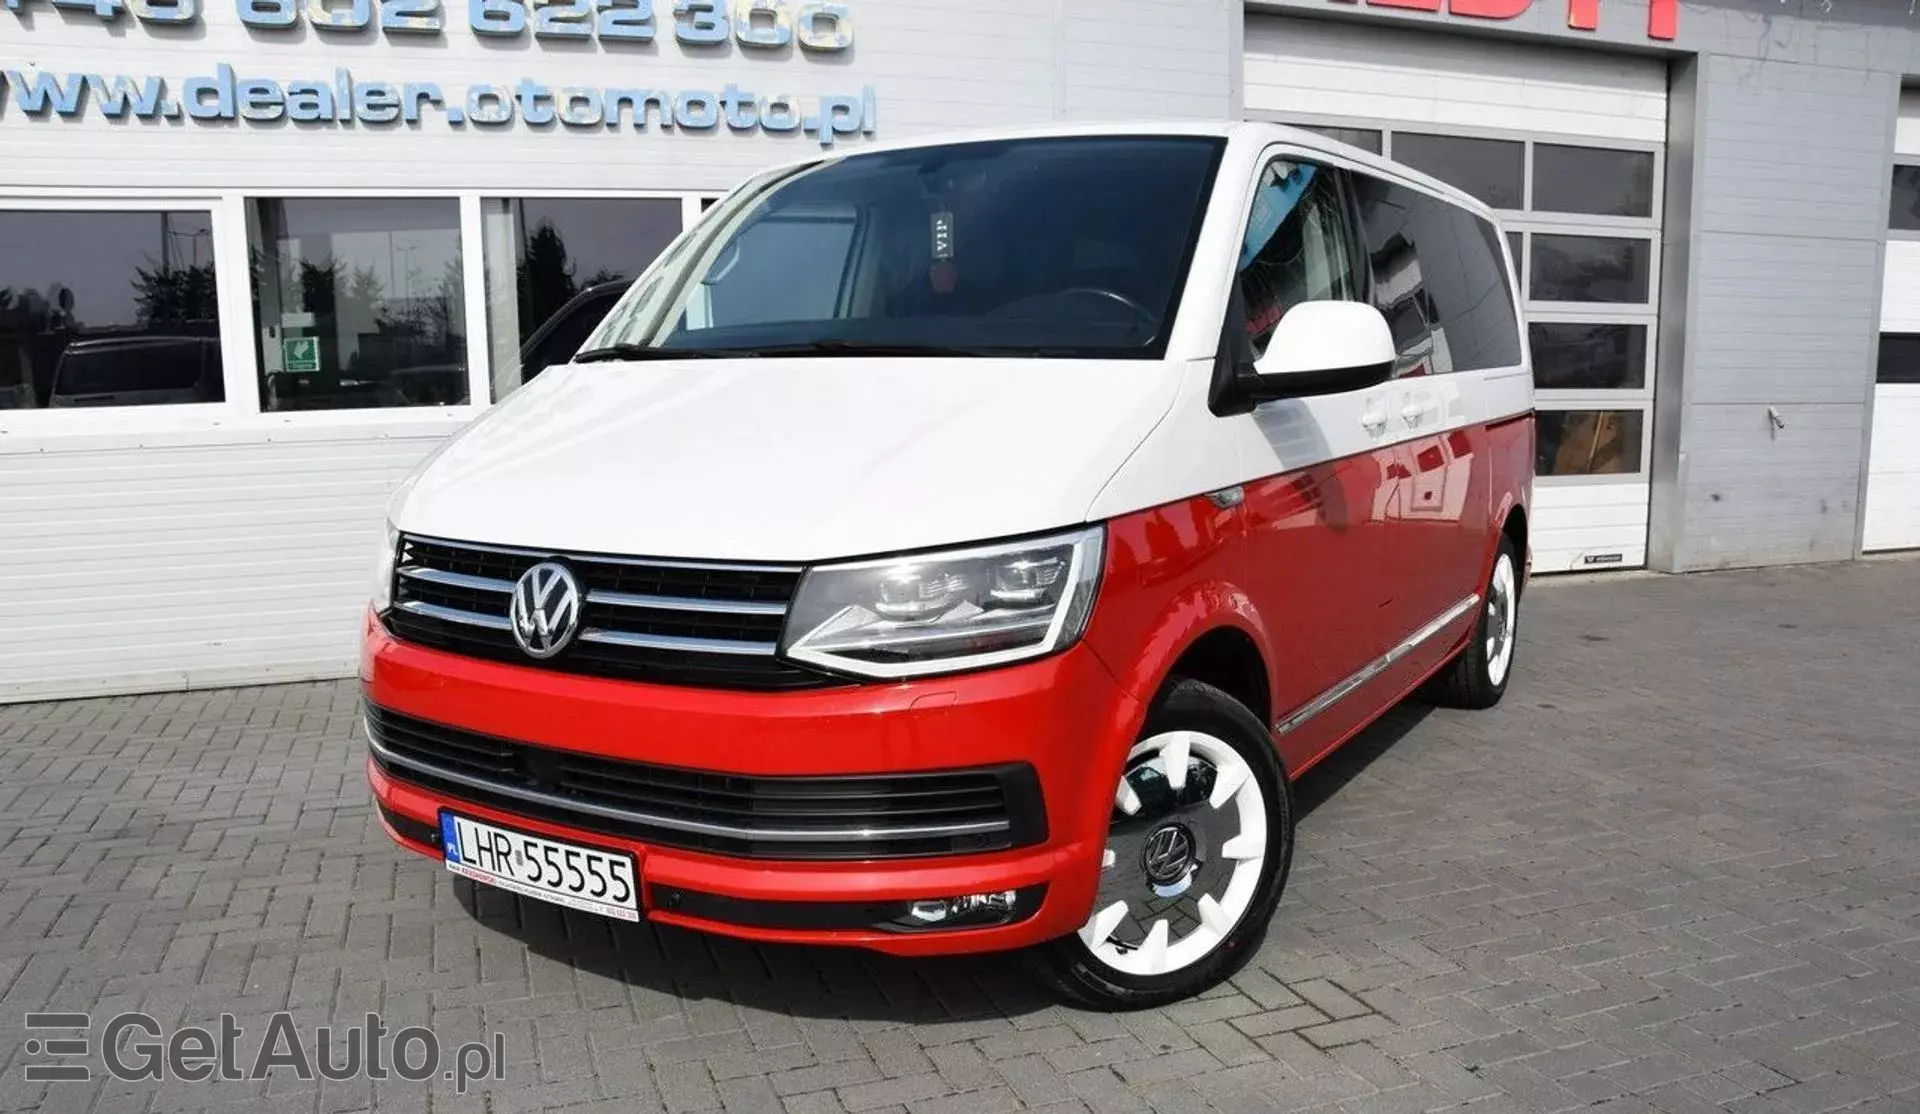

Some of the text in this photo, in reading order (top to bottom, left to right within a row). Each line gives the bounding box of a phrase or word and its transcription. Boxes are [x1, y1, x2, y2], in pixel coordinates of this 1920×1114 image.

[470, 0, 655, 41] 622
[673, 0, 854, 51] 300
[0, 62, 877, 146] ww.dealer.otomoto.pl
[936, 219, 947, 252] VIP
[457, 822, 515, 876] LHR
[523, 840, 631, 903] 55555
